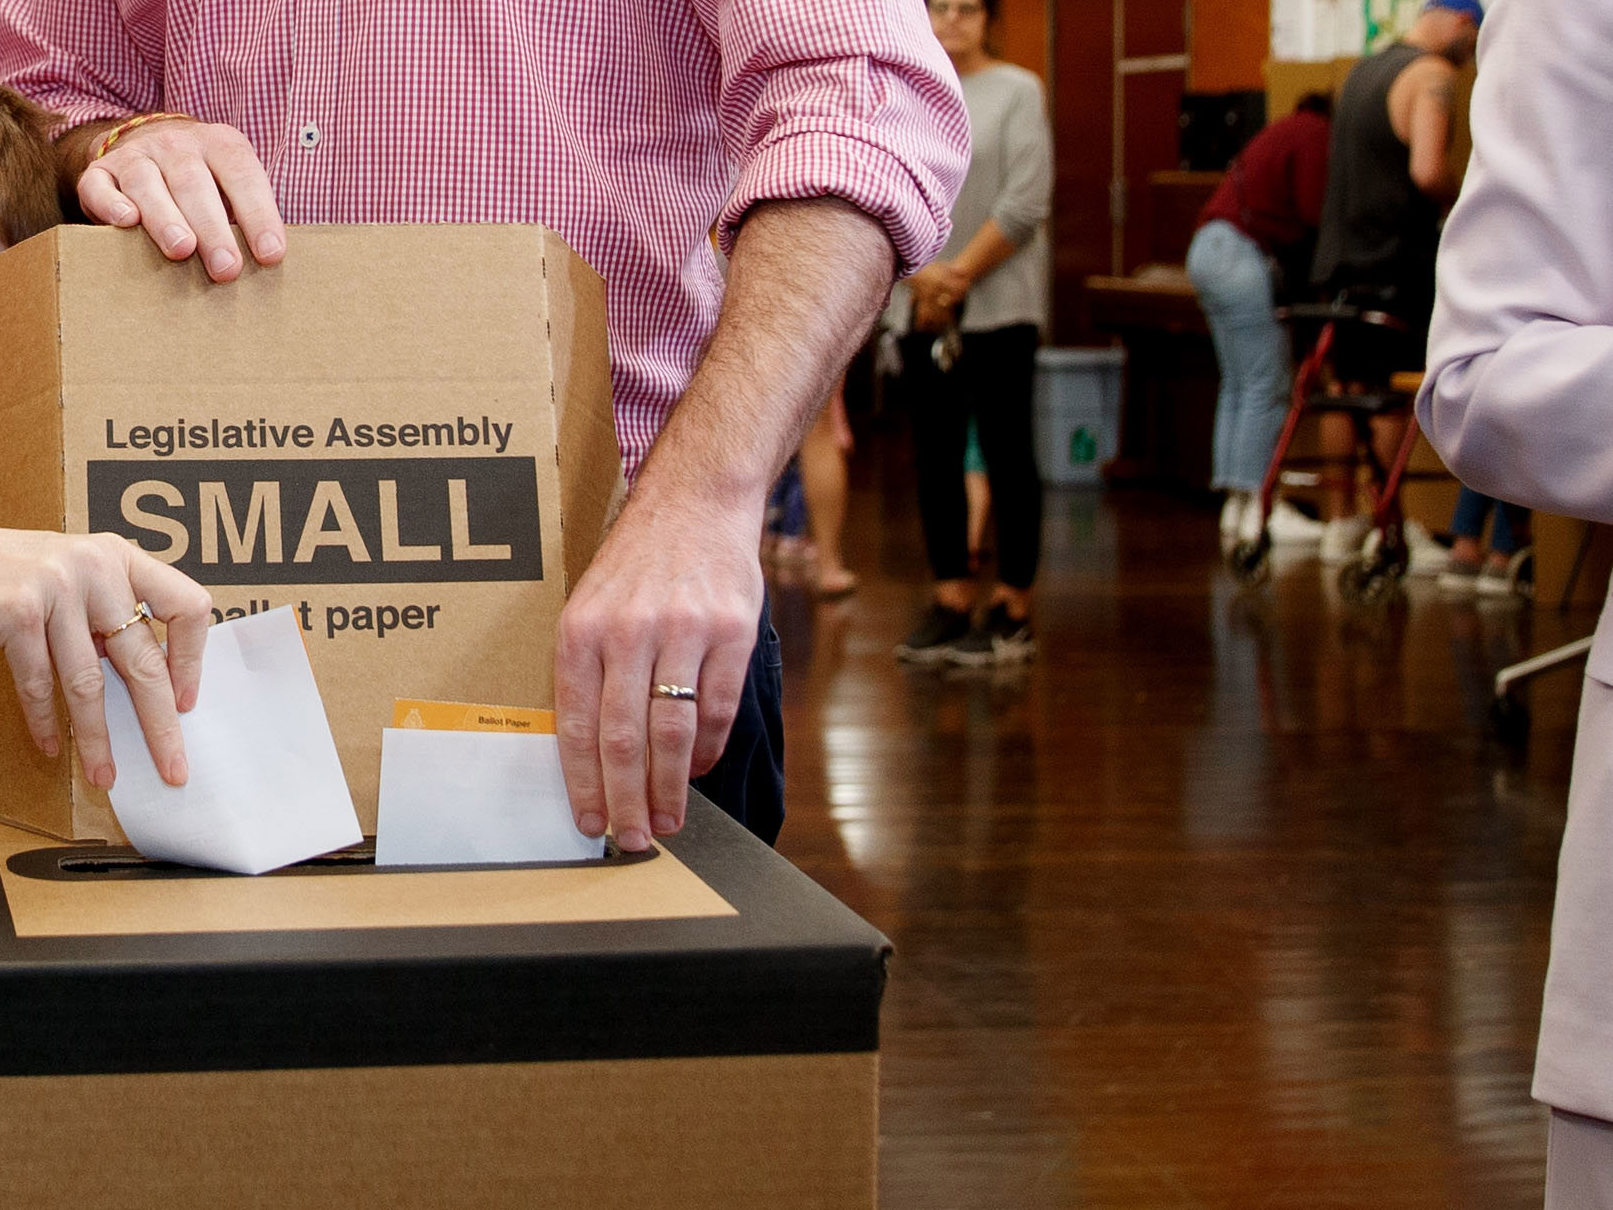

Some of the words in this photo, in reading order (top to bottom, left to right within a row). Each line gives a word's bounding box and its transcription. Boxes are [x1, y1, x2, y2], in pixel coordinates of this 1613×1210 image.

[105, 417, 315, 457] Legislative
[324, 415, 513, 454] Assembly
[119, 478, 513, 565] SMALL
[326, 604, 441, 639] paper
[477, 715, 504, 726] Ballot
[505, 717, 531, 729] Paper
